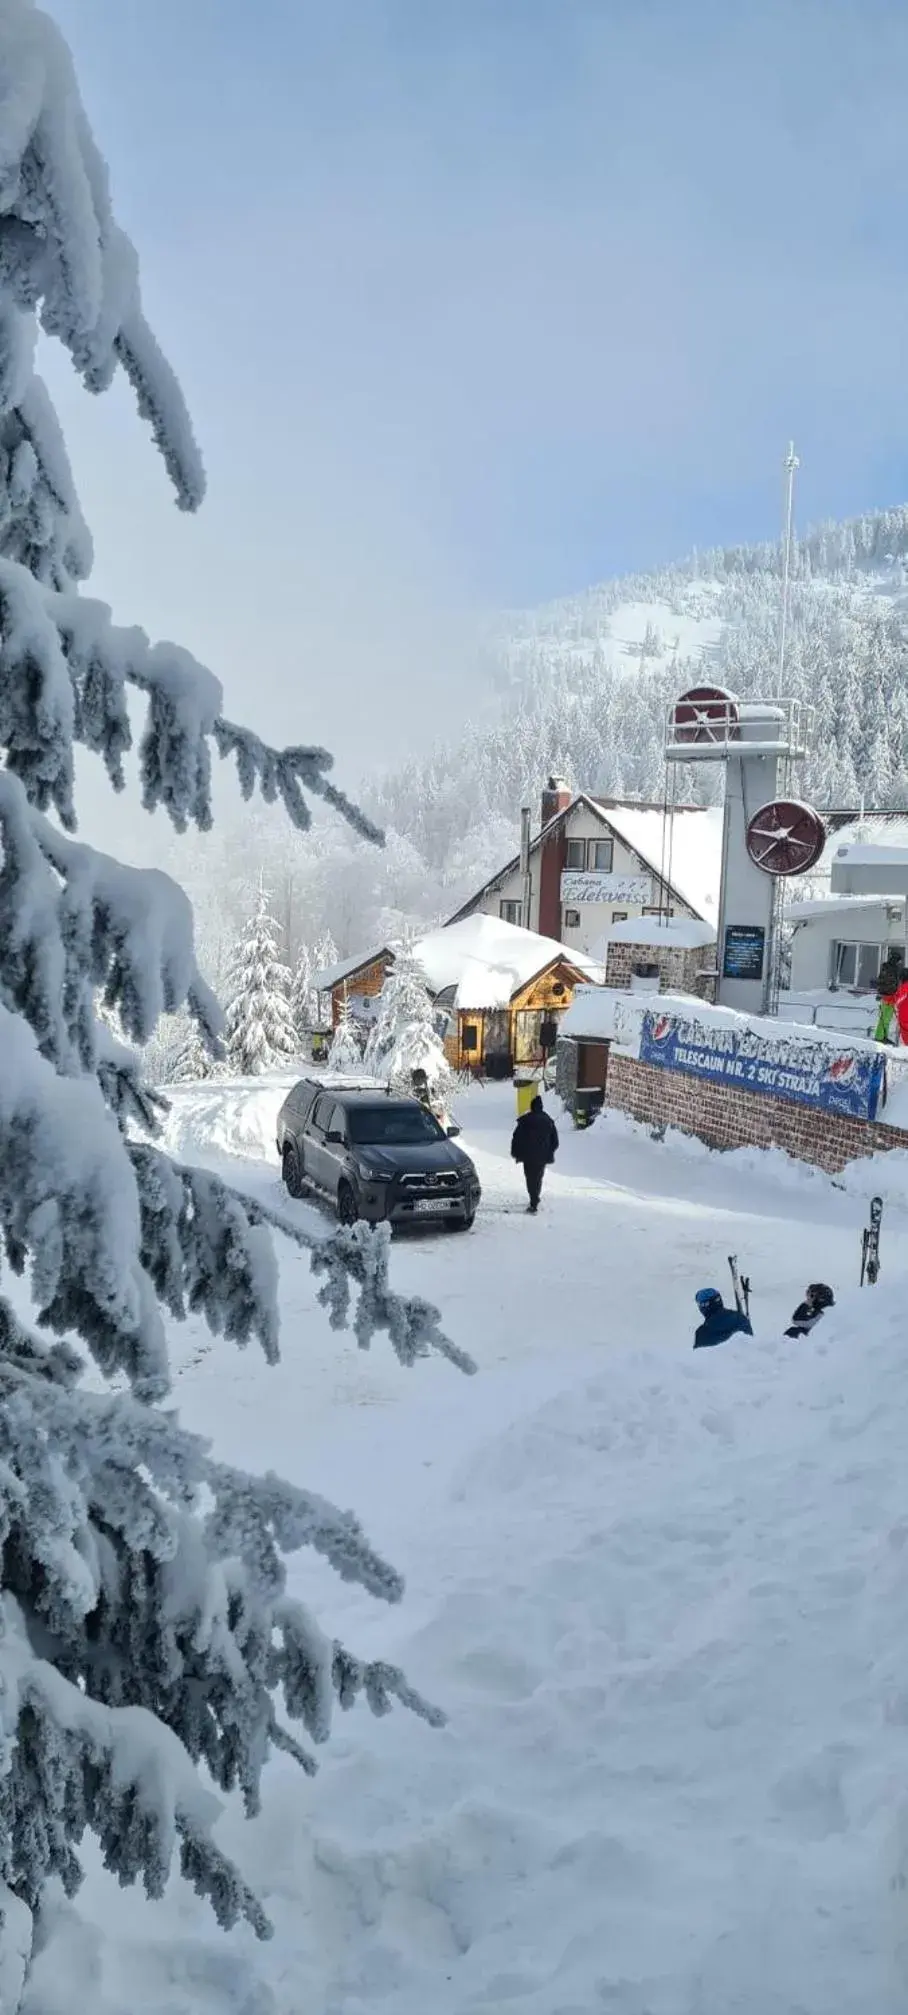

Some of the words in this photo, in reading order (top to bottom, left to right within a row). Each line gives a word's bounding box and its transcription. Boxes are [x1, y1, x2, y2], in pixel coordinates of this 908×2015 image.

[563, 886, 649, 904] Edelweiss
[674, 1047, 725, 1073] TELESCAUN
[726, 1060, 744, 1078] NR.
[747, 1064, 756, 1080] 2
[757, 1067, 777, 1086] SKI
[779, 1071, 820, 1097] STRAJA
